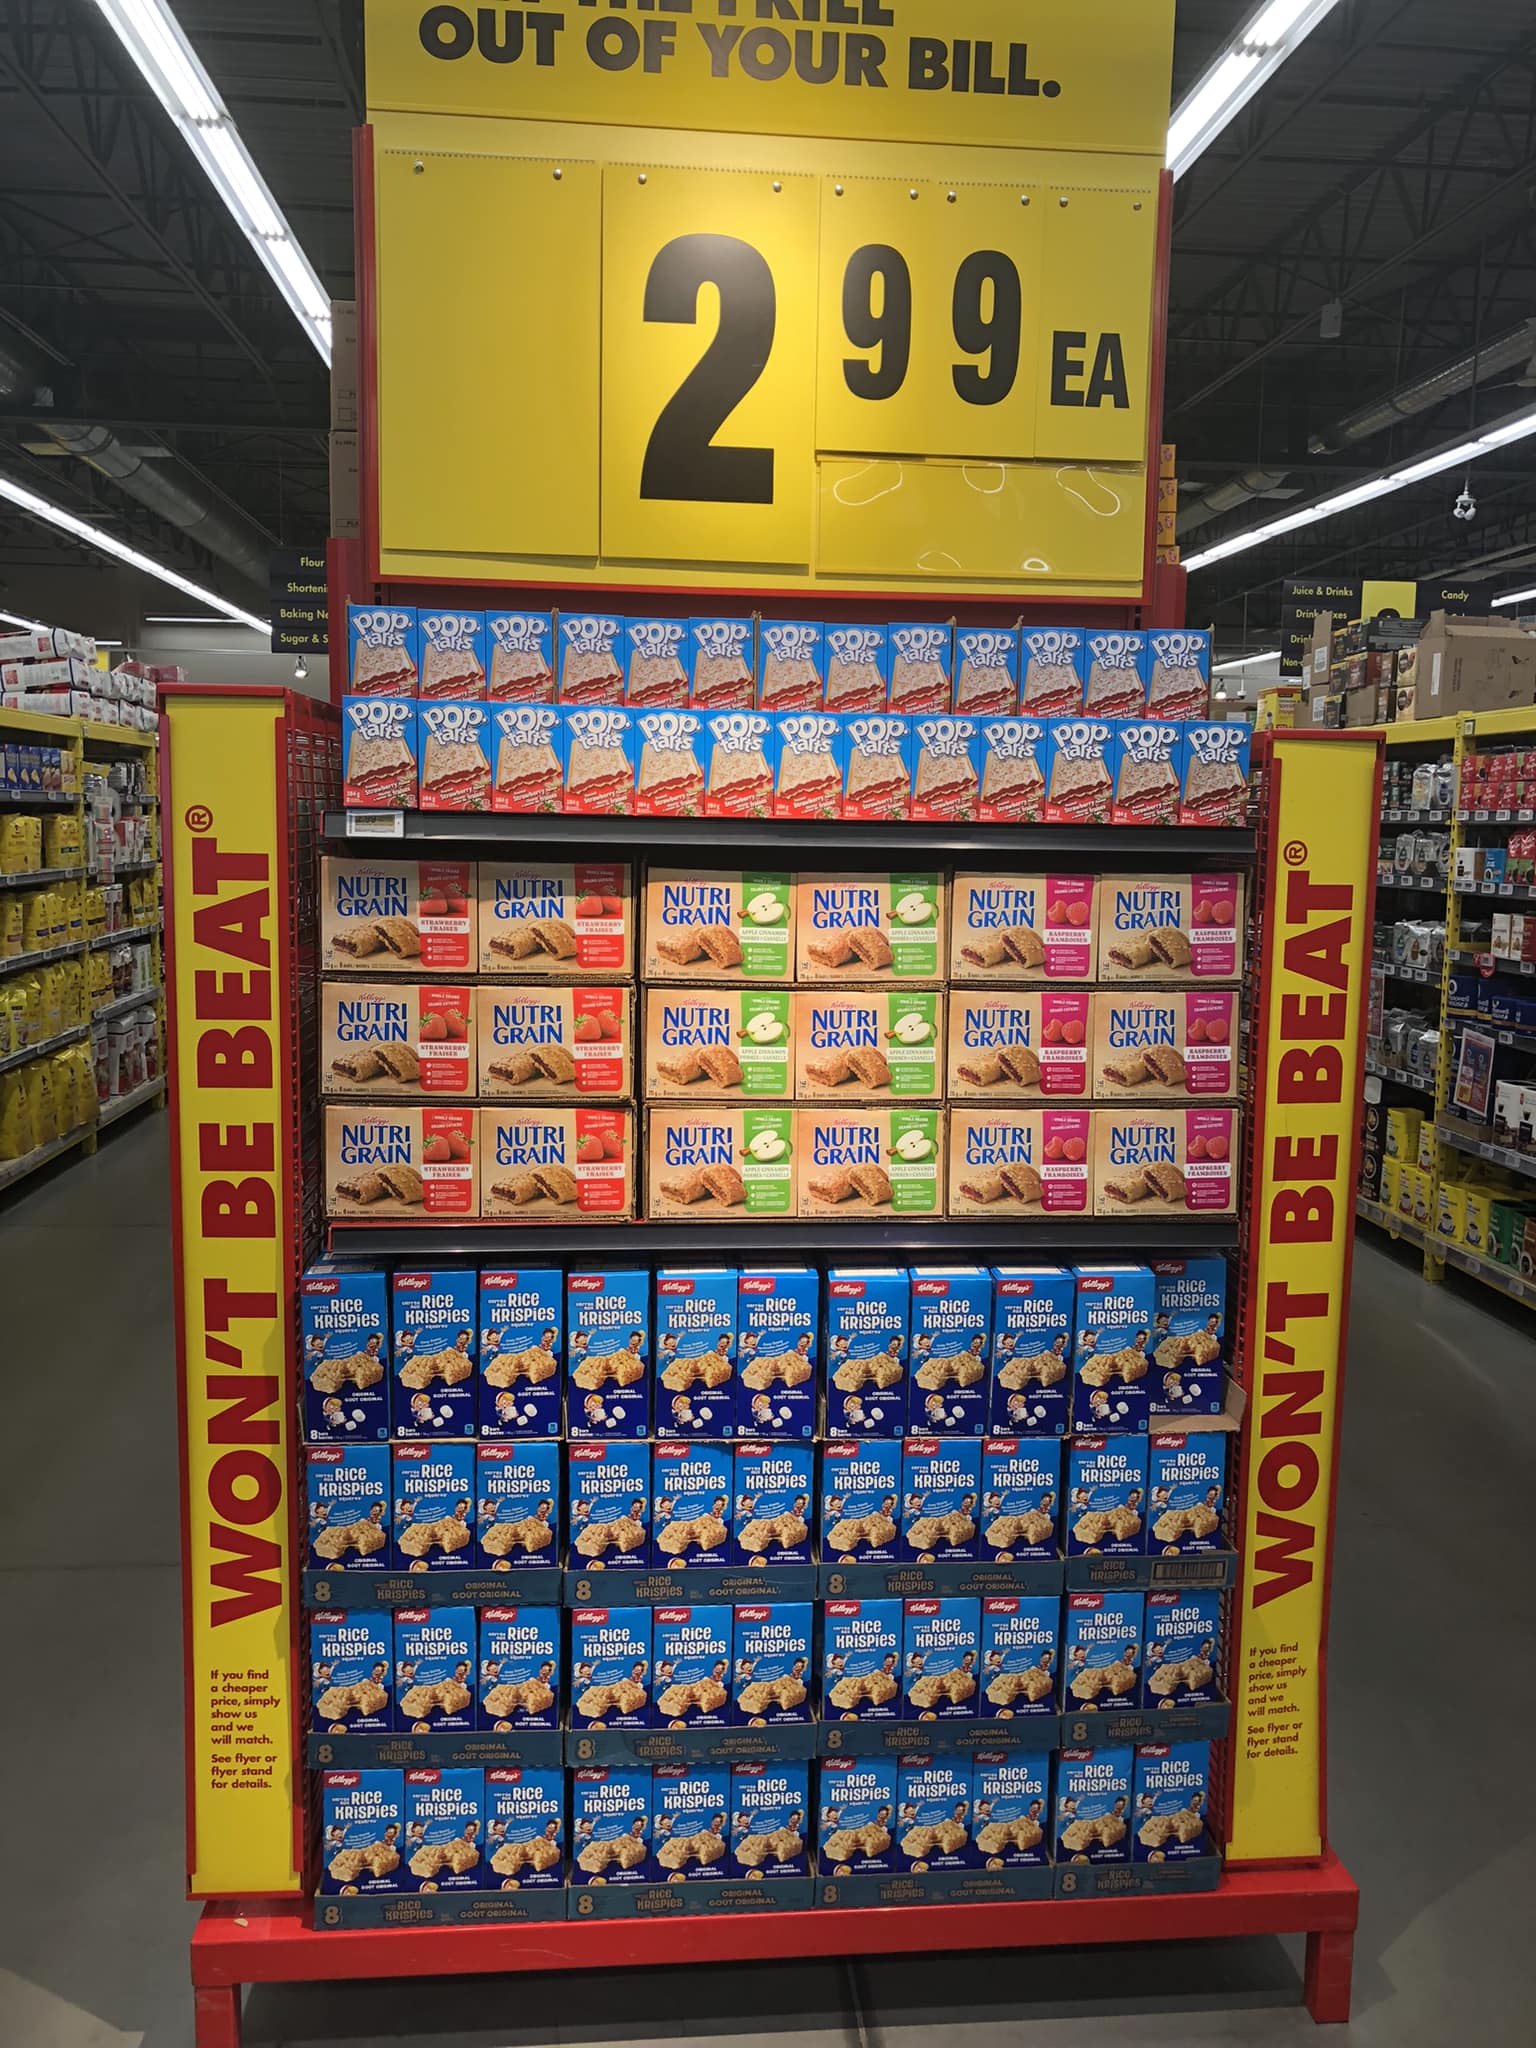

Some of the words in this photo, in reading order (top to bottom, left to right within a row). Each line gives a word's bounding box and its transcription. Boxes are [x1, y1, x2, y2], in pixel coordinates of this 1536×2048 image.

[419, 5, 565, 66] OUT
[586, 16, 676, 73] OF
[697, 23, 888, 88] YOUR
[908, 37, 1062, 98] BILL.
[640, 233, 776, 504] 2
[1050, 331, 1130, 409] EA
[300, 557, 325, 568] Flour
[287, 582, 328, 593] Shorteni
[1292, 585, 1314, 596] Juice
[1316, 586, 1323, 596] &
[1326, 587, 1353, 597] Drinks
[1441, 590, 1469, 602] Candy
[280, 608, 314, 621] Baking
[280, 633, 309, 645] Sugar
[311, 634, 320, 644] &
[495, 879, 563, 901] NUTRI
[664, 886, 730, 908] NUTRI
[494, 899, 564, 920] GRAIN
[1116, 891, 1181, 913] NUTRI
[663, 905, 731, 926] GRAIN
[1115, 909, 1181, 930] GRAIN
[338, 1002, 407, 1023] NUTRI
[812, 1010, 877, 1031] NUTRI
[966, 1010, 1030, 1031] NUTRI
[337, 1021, 407, 1042] GRAIN
[811, 1028, 877, 1048] GRAIN
[964, 1028, 1030, 1047] GRAIN
[342, 1124, 410, 1147] NUTRI
[666, 1127, 732, 1149] NUTRI
[1111, 1127, 1174, 1148] NUTRI
[341, 1144, 411, 1165] GRAIN
[665, 1145, 733, 1166] GRAIN
[1110, 1144, 1175, 1164] GRAIN
[199, 1121, 277, 1240] BE
[1270, 1135, 1334, 1245] BE
[311, 1430, 318, 1440] 8
[203, 1277, 282, 1628] WON'T
[1252, 1281, 1330, 1609] WON'T
[315, 1581, 331, 1601] 8
[465, 1582, 507, 1590] ORIGINAL
[479, 1590, 522, 1599] ORIGINAL
[1250, 1647, 1257, 1656] If
[1259, 1648, 1277, 1657] you
[1280, 1642, 1298, 1653] find
[1258, 1656, 1296, 1668] cheaper
[211, 1670, 219, 1679] If
[222, 1672, 243, 1681] you
[247, 1670, 269, 1679] find
[1249, 1671, 1273, 1683] price,
[1276, 1666, 1307, 1678] simply
[222, 1683, 268, 1694] cheaper
[1248, 1682, 1274, 1692] show
[1277, 1682, 1287, 1690] us
[211, 1696, 241, 1707] price,
[244, 1696, 281, 1707] simply
[1248, 1695, 1266, 1705] and
[211, 1709, 241, 1718] show
[1248, 1707, 1264, 1717] will
[1268, 1704, 1300, 1715] match.
[211, 1722, 233, 1731] and
[1247, 1726, 1264, 1734] See
[1268, 1723, 1289, 1733] flyer
[211, 1735, 231, 1744] will
[236, 1735, 273, 1744] match.
[1247, 1737, 1269, 1748] flyer
[1273, 1732, 1299, 1743] stand
[211, 1754, 231, 1763] See
[235, 1753, 261, 1764] flyer
[265, 1755, 277, 1763] or
[1247, 1750, 1260, 1759] for
[1264, 1745, 1298, 1757] details.
[211, 1766, 237, 1778] flyer
[241, 1766, 272, 1775] stand
[211, 1780, 228, 1789] for
[231, 1779, 272, 1788] details.
[324, 1906, 340, 1925] 8
[487, 1909, 528, 1918] ORIGINAL
